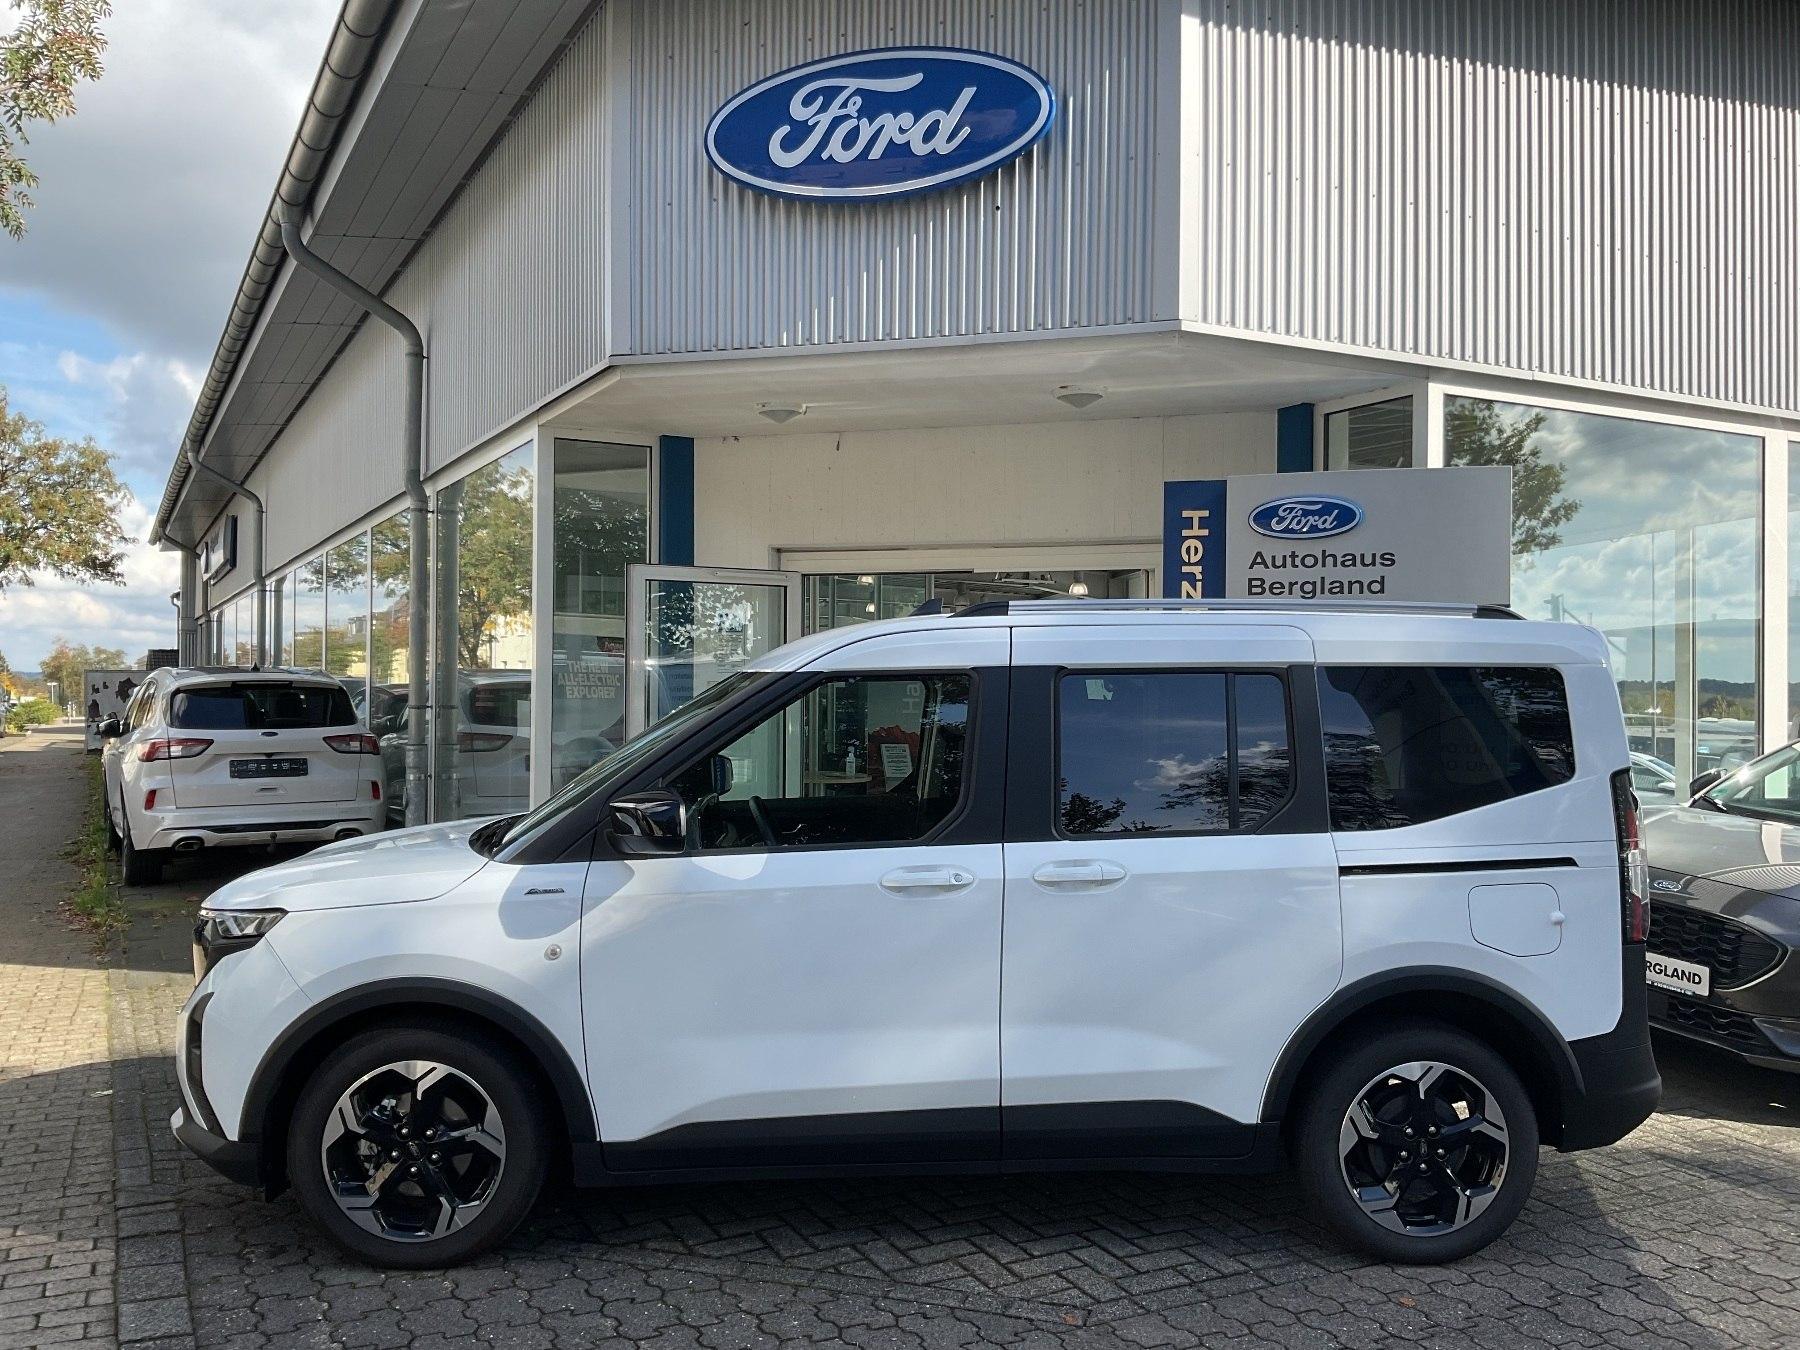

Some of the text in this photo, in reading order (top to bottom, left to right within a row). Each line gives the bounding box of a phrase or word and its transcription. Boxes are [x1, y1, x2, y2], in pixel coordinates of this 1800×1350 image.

[767, 72, 978, 168] Ford
[1269, 502, 1340, 532] Ford
[1248, 549, 1396, 570] Autohaus
[1247, 576, 1386, 600] Bergland
[567, 660, 609, 674] THE NEW
[557, 673, 621, 686] ALL-ELECTRIC
[565, 686, 616, 699] EXPLORER
